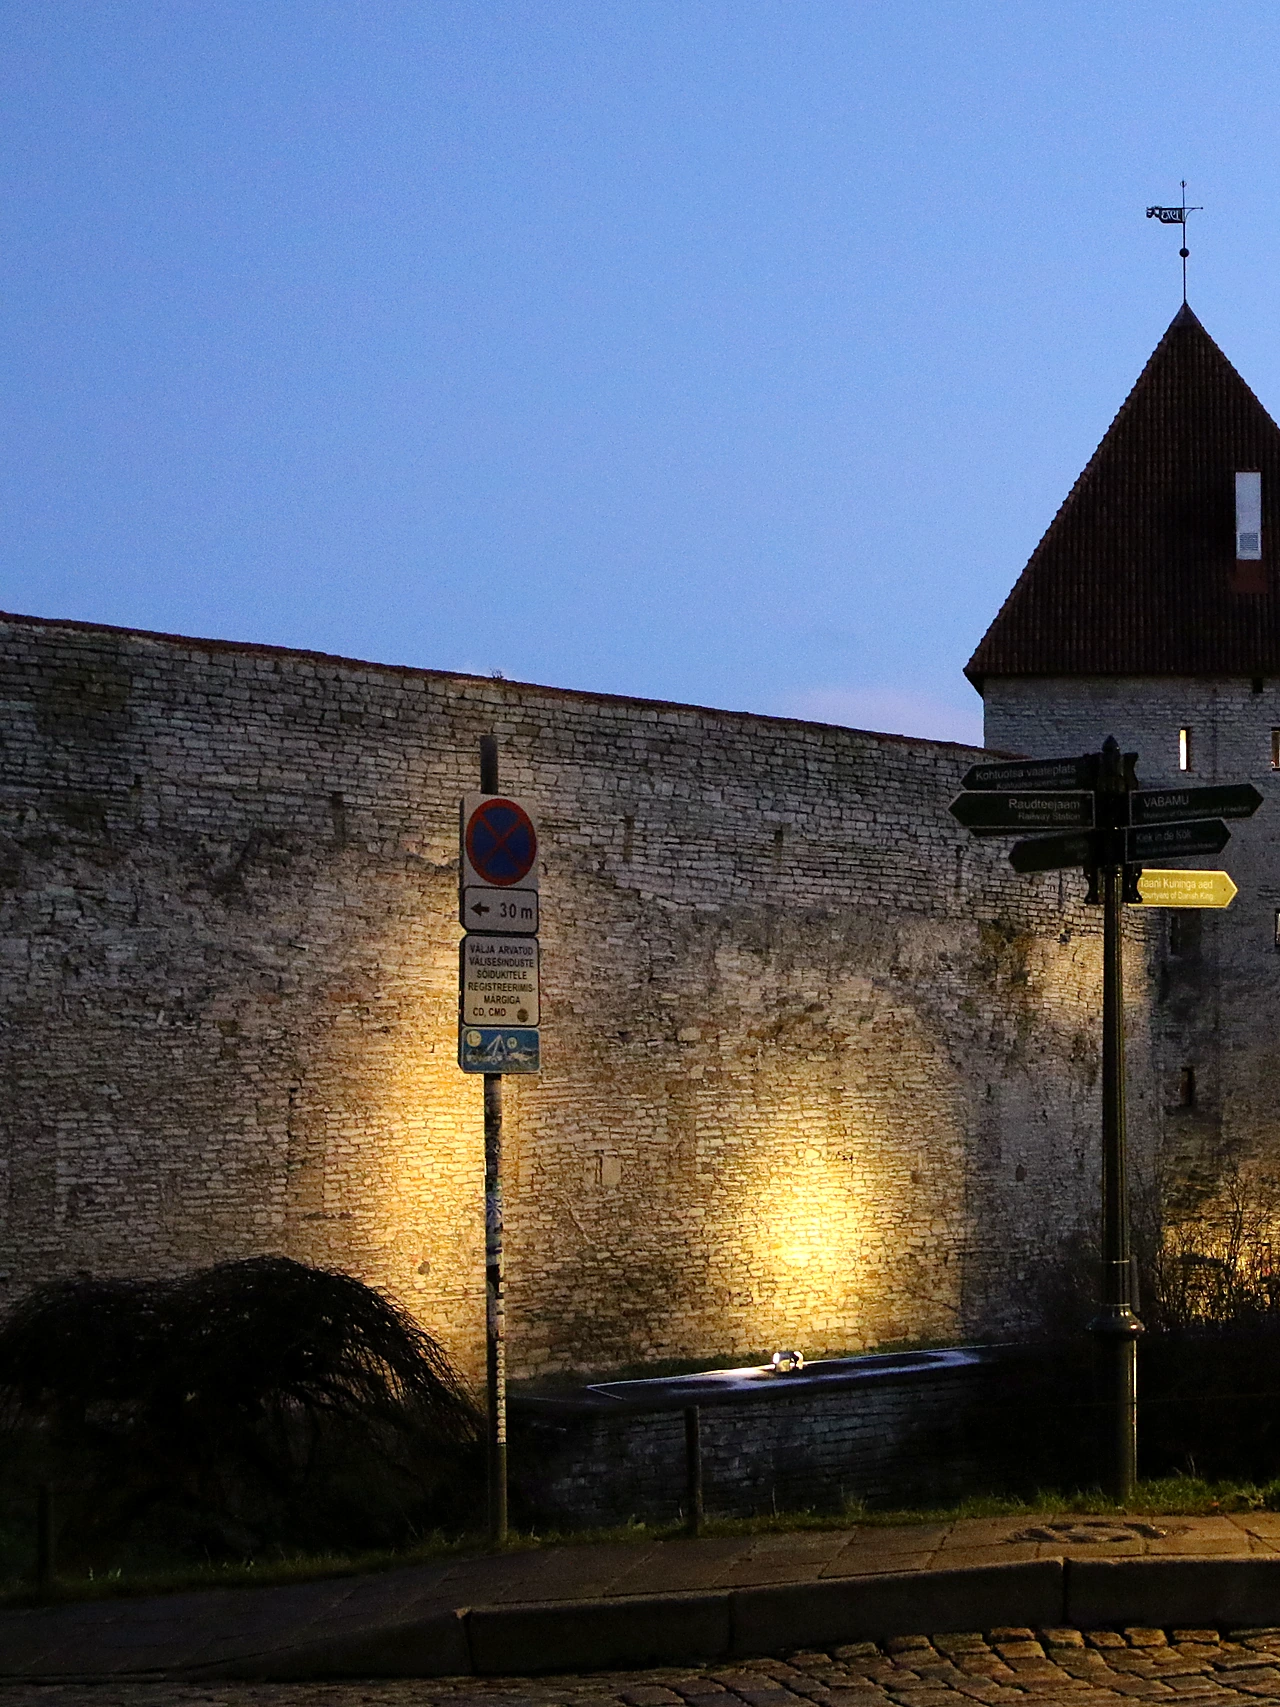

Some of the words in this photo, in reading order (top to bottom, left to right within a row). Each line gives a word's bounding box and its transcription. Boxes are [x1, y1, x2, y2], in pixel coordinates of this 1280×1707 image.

[975, 768, 1024, 781] Kohtuotsa
[1026, 764, 1077, 778] vaateplats
[1008, 797, 1080, 811] Raudteejaam
[1143, 795, 1190, 808] VABAMU
[1018, 812, 1050, 822] Railway
[1052, 811, 1081, 821] Station
[1139, 877, 1161, 888] Taani
[1163, 878, 1197, 891] Kuninga
[1198, 879, 1213, 889] aed
[1200, 891, 1214, 902] King
[500, 902, 517, 919] 30
[521, 907, 533, 920] m
[470, 942, 495, 954] VÄLJA
[498, 944, 534, 956] ARVATUD
[468, 981, 536, 992] REGISTREERIMIS-
[488, 1007, 507, 1017] CMD
